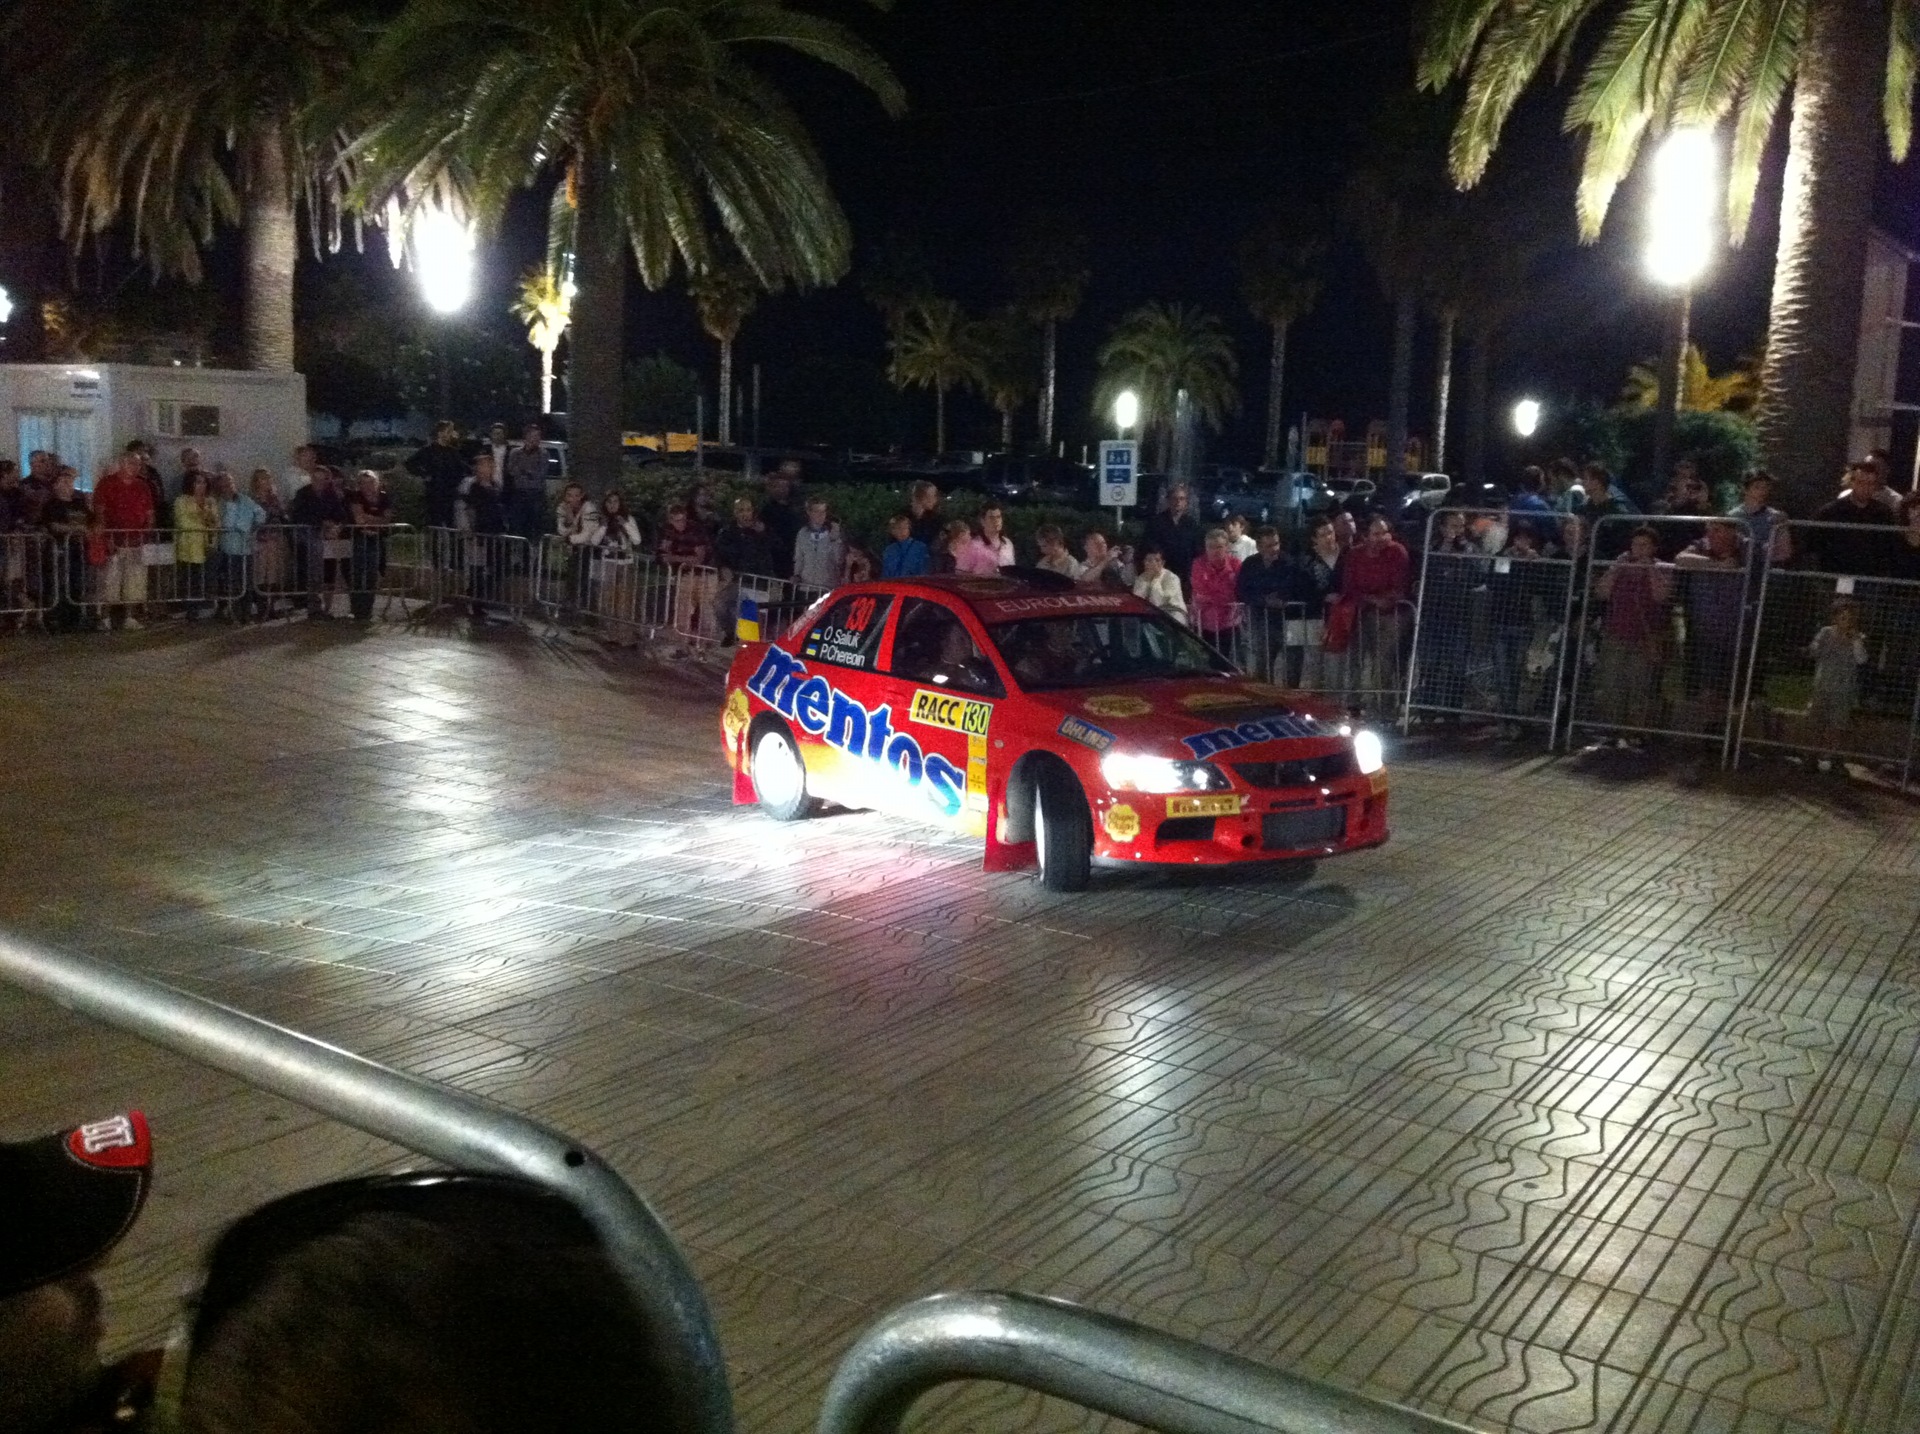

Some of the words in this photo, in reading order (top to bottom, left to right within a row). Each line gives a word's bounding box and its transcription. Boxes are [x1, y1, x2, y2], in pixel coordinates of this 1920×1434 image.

[846, 597, 876, 631] 130
[746, 643, 966, 816] mentos
[916, 695, 959, 726] RACC
[965, 703, 989, 733] 130
